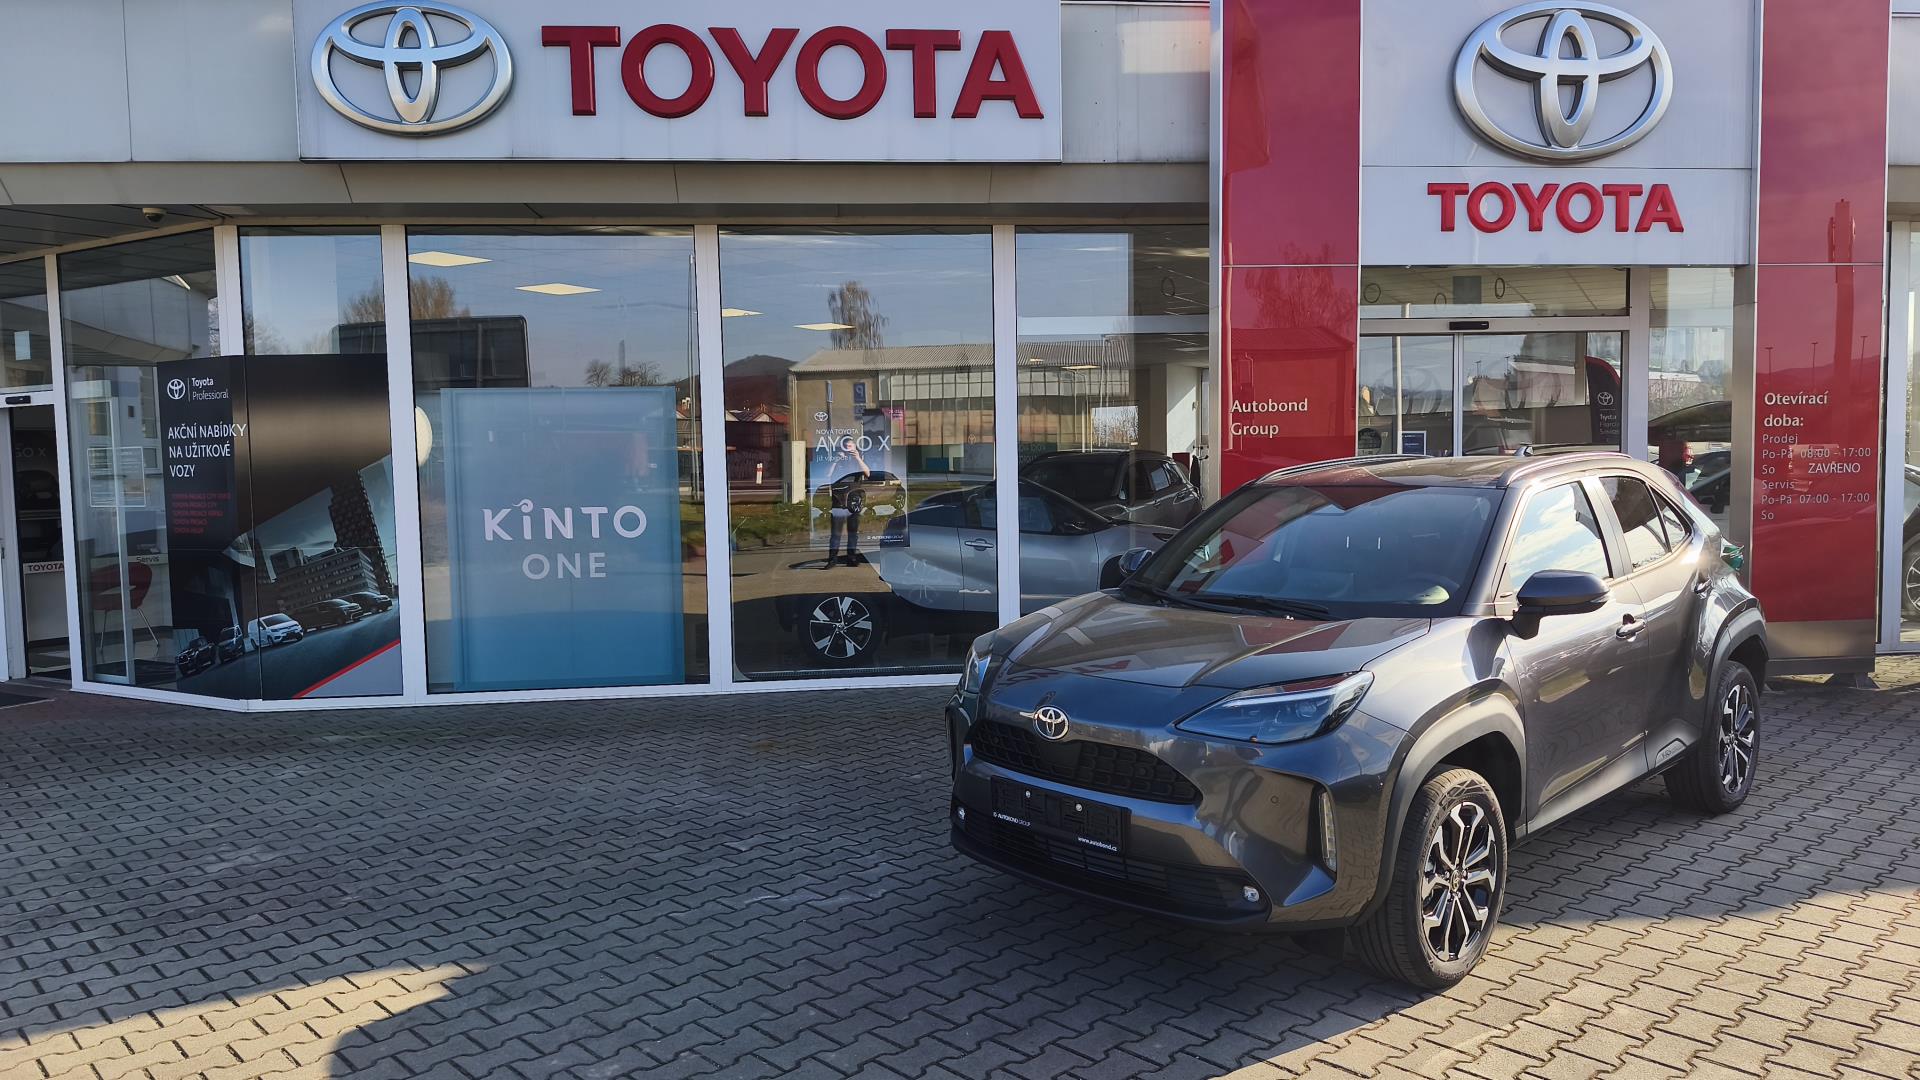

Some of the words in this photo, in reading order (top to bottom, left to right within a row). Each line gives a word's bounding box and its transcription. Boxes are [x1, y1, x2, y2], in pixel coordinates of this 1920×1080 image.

[541, 24, 1044, 119] TOYOTA
[1427, 182, 1684, 233] TOYOTA
[191, 377, 214, 388] Toyota
[192, 388, 229, 400] Professional
[1764, 390, 1829, 405] Otevírací
[1231, 398, 1308, 412] Autobond
[1764, 414, 1804, 427] doba:
[168, 422, 197, 439] AKČNÍ
[199, 421, 247, 438] NABÍDKY
[1230, 422, 1279, 438] Group
[878, 435, 890, 451] X
[1762, 433, 1798, 445] Prodej
[169, 446, 183, 458] NA
[185, 441, 231, 458] UŽITKOVÉ
[1762, 447, 1793, 459] Po-Pá
[1800, 448, 1830, 458] 08:00
[1843, 447, 1871, 457] 17:00
[169, 464, 195, 477] VOZY
[1761, 464, 1775, 474] So
[1808, 461, 1860, 474] ZAVŘENO
[1762, 480, 1794, 490] Servis
[1761, 495, 1792, 505] Po-Pá
[1800, 494, 1829, 504] 07:00
[1841, 493, 1870, 503] 17:00
[1761, 510, 1774, 520] So
[28, 562, 64, 572] TOYOTA
[522, 552, 606, 580] ONE
